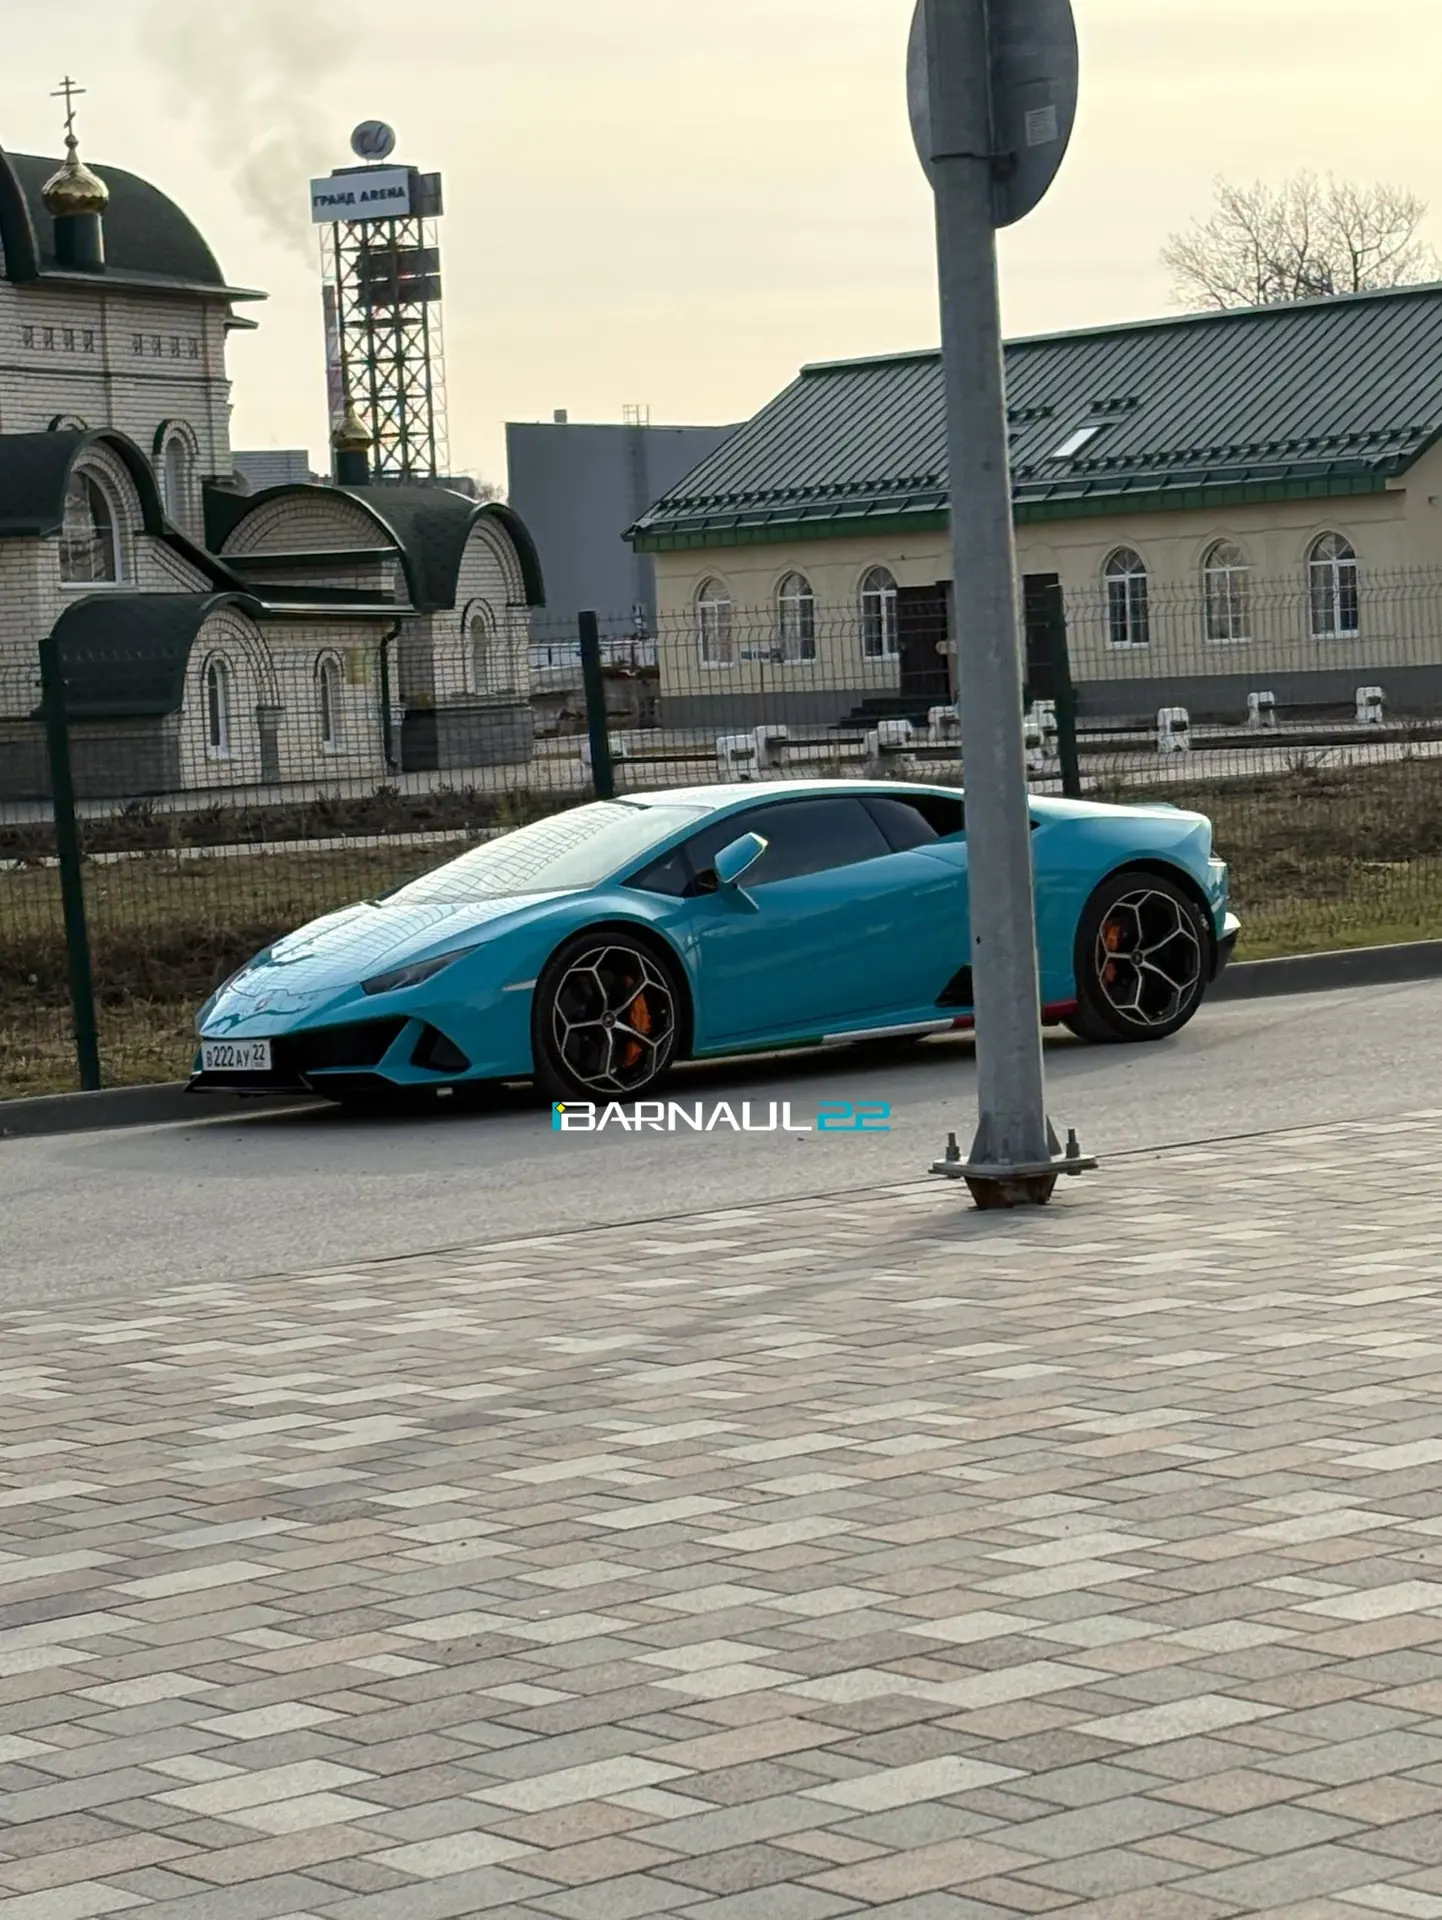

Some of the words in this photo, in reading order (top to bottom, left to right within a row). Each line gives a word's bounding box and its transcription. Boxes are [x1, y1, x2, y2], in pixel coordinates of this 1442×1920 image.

[313, 191, 356, 208] ГРАНД
[360, 186, 406, 202] ARENA
[252, 1043, 265, 1061] 22
